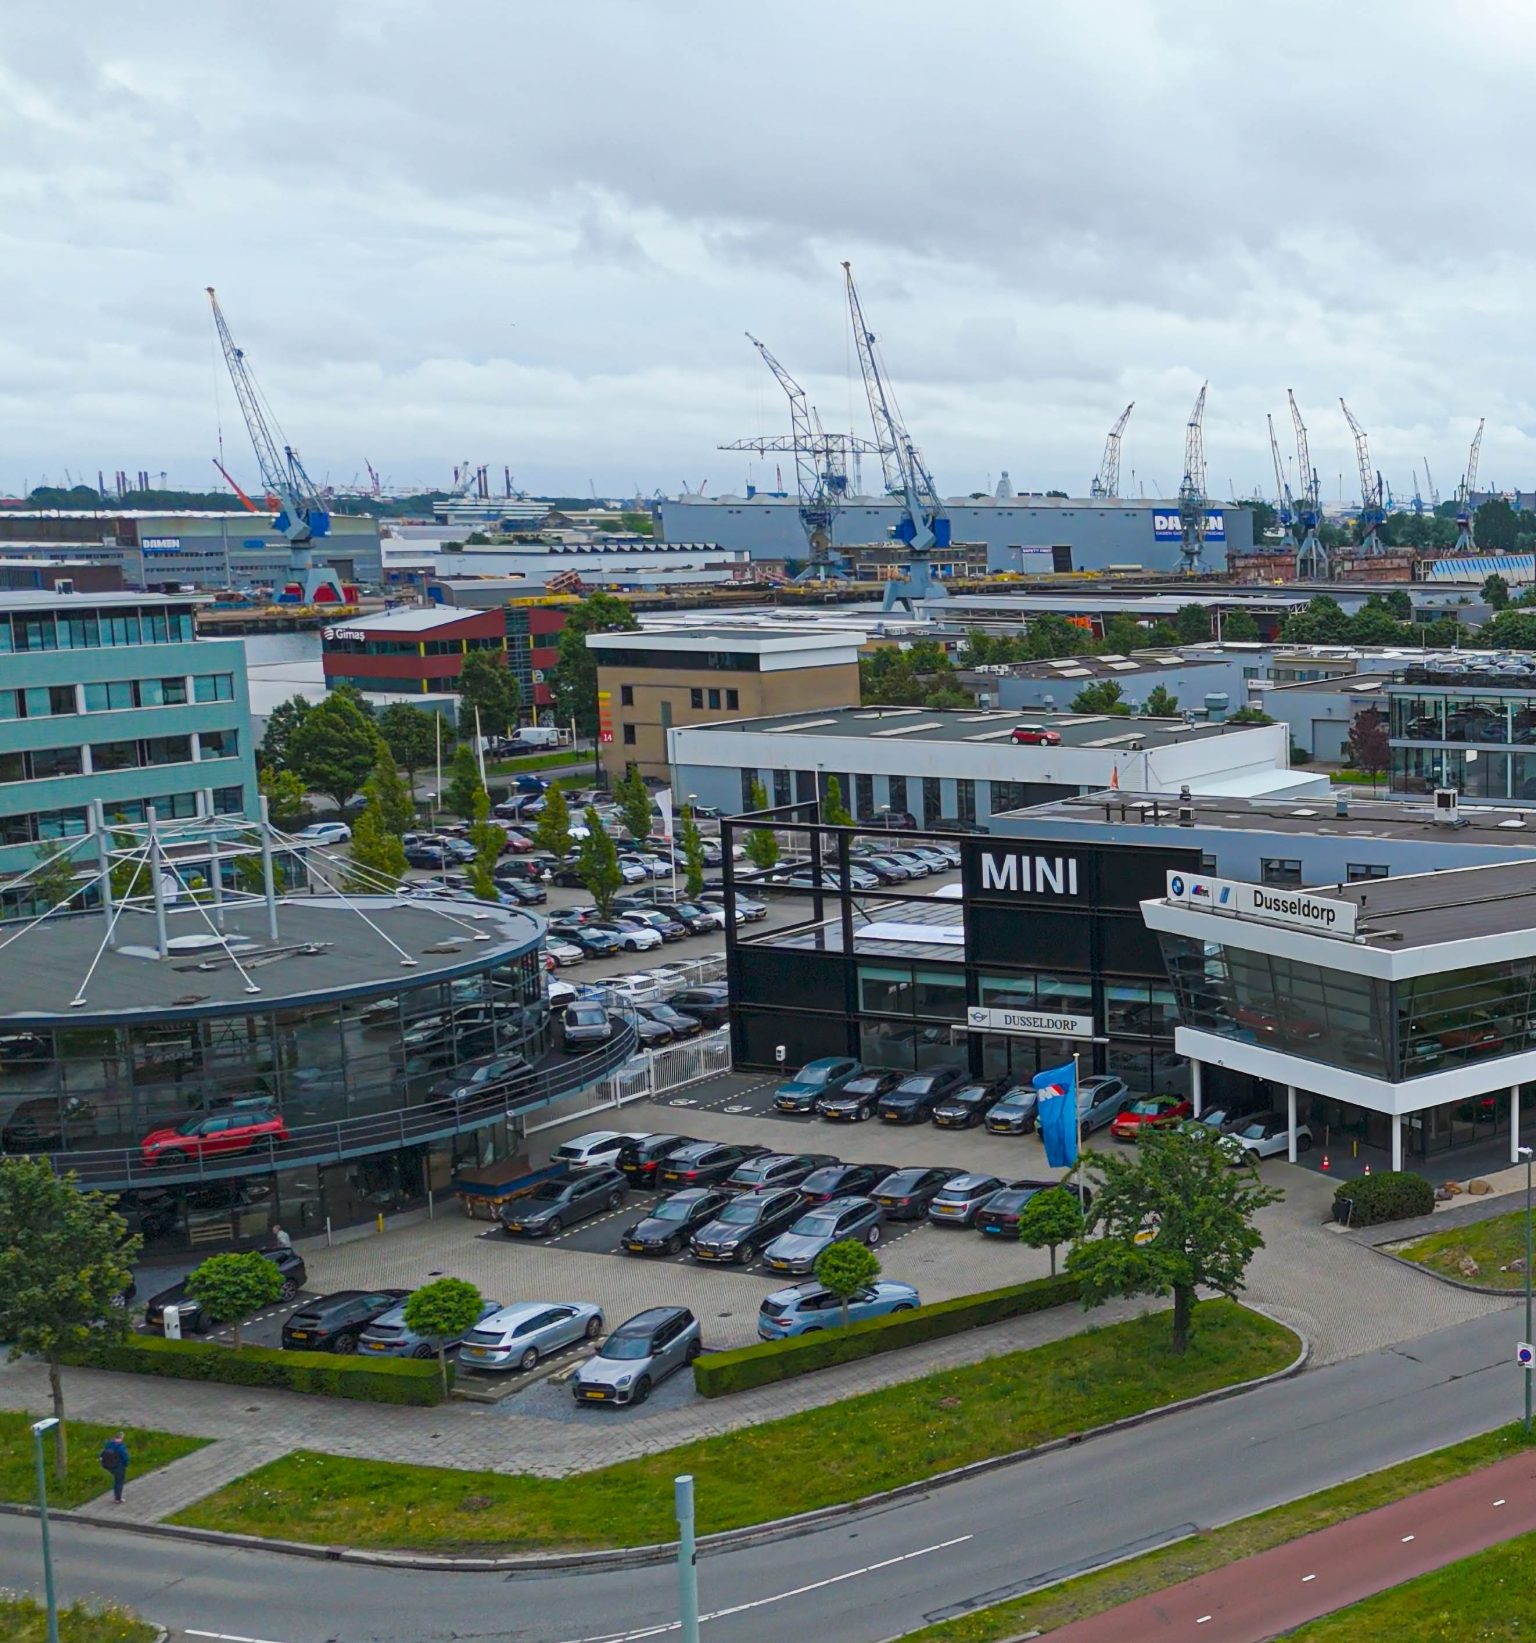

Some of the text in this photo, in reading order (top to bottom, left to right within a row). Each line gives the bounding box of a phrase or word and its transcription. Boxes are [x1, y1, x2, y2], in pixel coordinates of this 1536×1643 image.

[142, 539, 181, 548] DAMEN
[603, 733, 613, 742] 14
[981, 852, 1078, 895] MINI
[1253, 889, 1336, 925] Dusseldorp
[1003, 1014, 1078, 1031] DUSSELDORP
